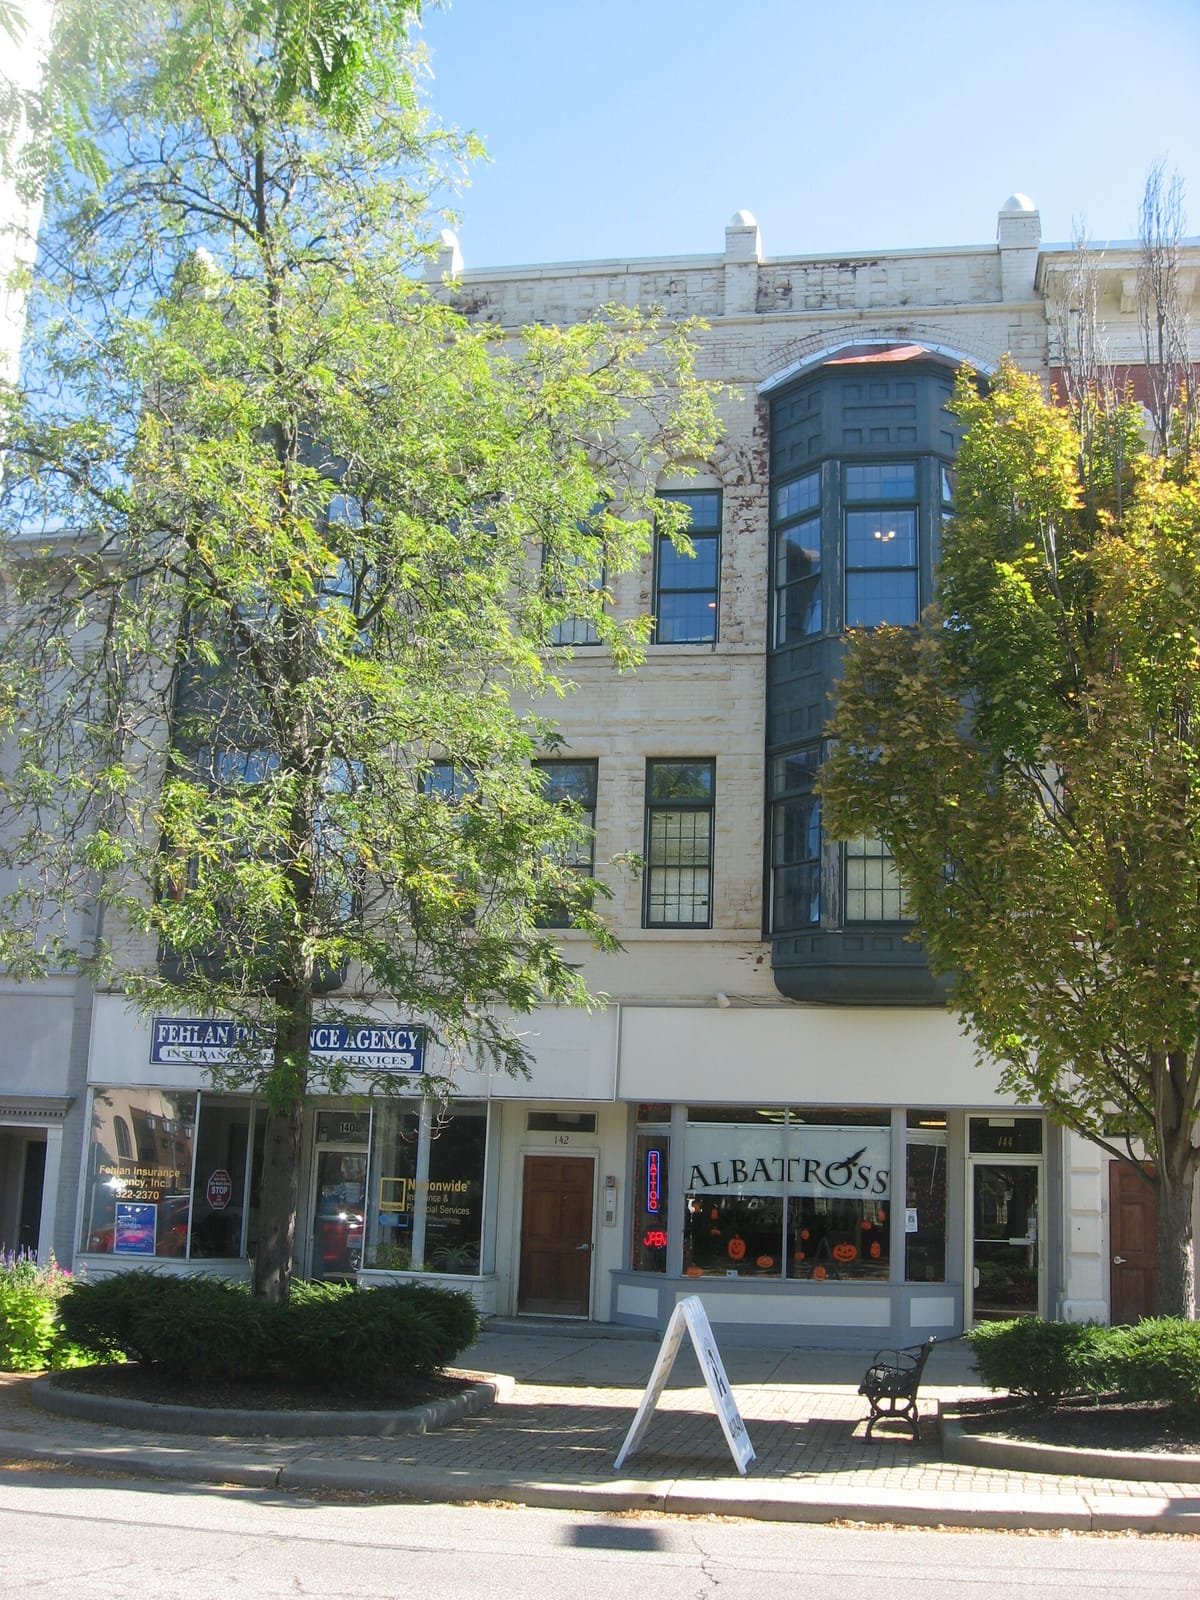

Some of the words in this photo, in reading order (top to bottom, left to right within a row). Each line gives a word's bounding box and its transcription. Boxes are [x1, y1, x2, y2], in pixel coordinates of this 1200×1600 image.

[157, 1024, 230, 1045] FEHLAN
[345, 1029, 420, 1051] AGENCY
[553, 1135, 570, 1145] 142
[99, 1165, 131, 1176] Fehlan
[133, 1166, 181, 1178] Insurance
[687, 1156, 890, 1195] ALBATROSS
[649, 1153, 658, 1210] TATTOO
[115, 1189, 160, 1200] 322-2370
[211, 1186, 228, 1195] STOP
[439, 1205, 470, 1216] Services
